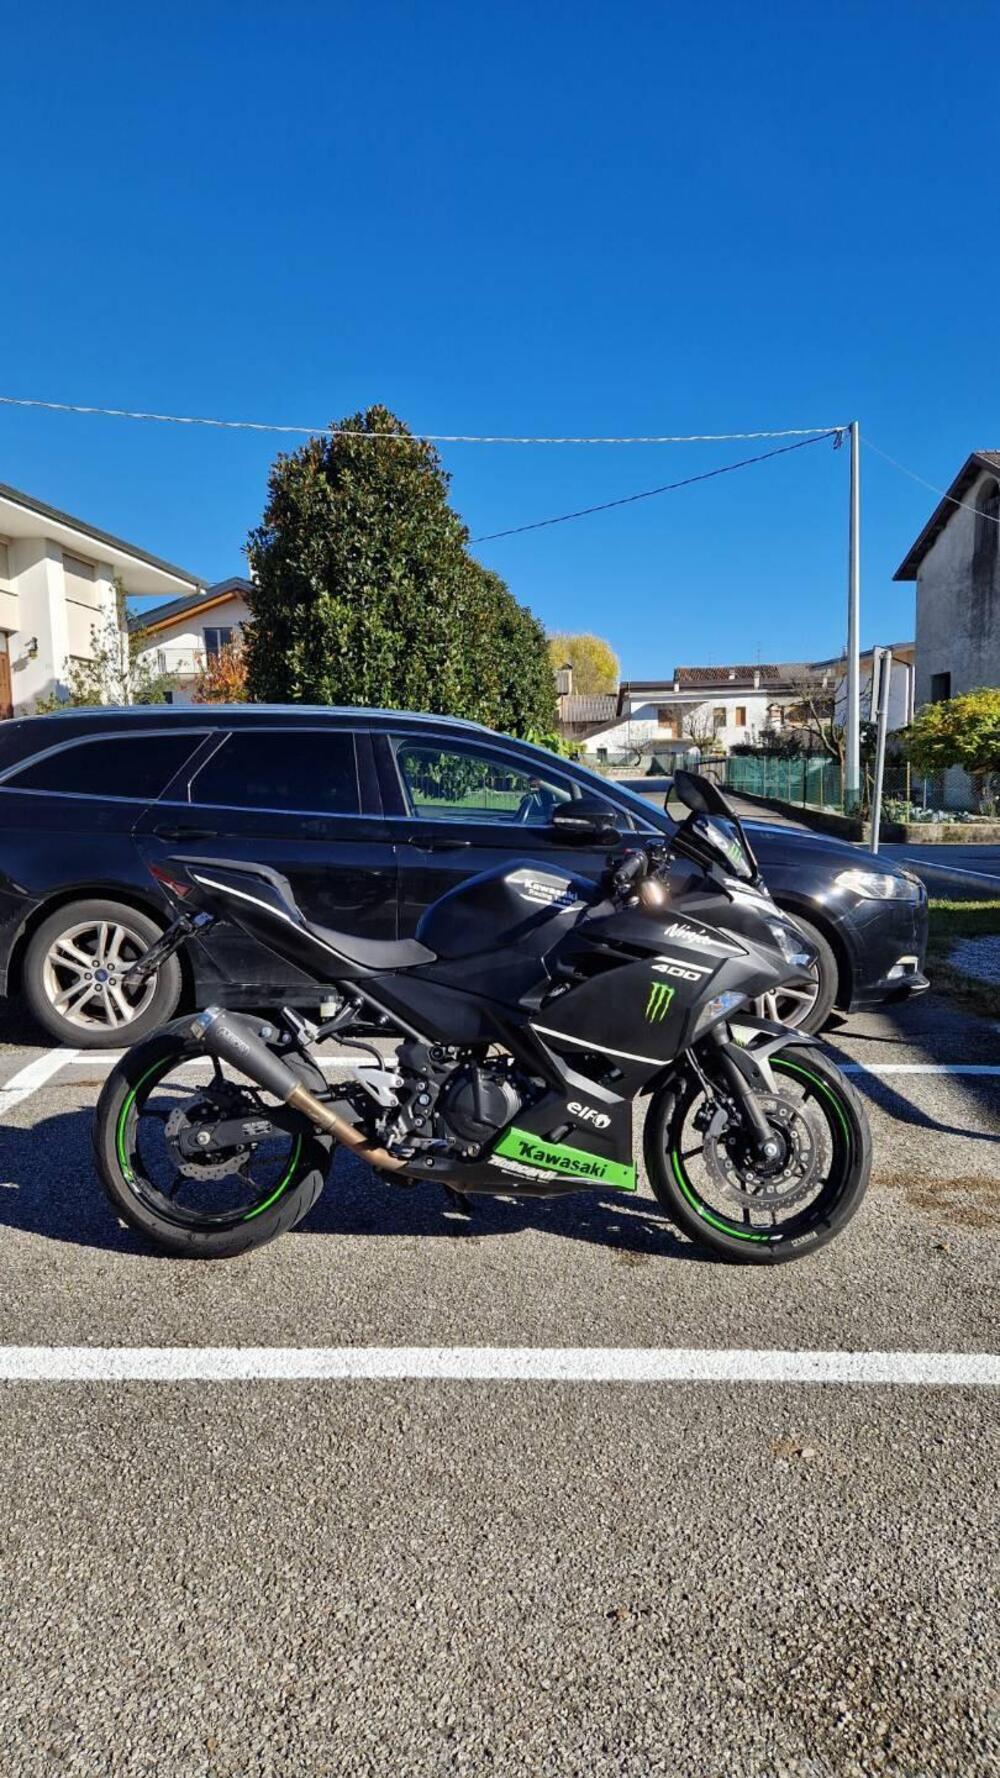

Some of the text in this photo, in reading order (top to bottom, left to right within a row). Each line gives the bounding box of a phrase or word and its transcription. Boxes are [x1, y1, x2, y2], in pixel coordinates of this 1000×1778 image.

[524, 879, 578, 900] Kawasaki
[664, 923, 711, 945] Ninja
[651, 964, 702, 981] 400
[518, 1141, 608, 1178] Kawasaki
